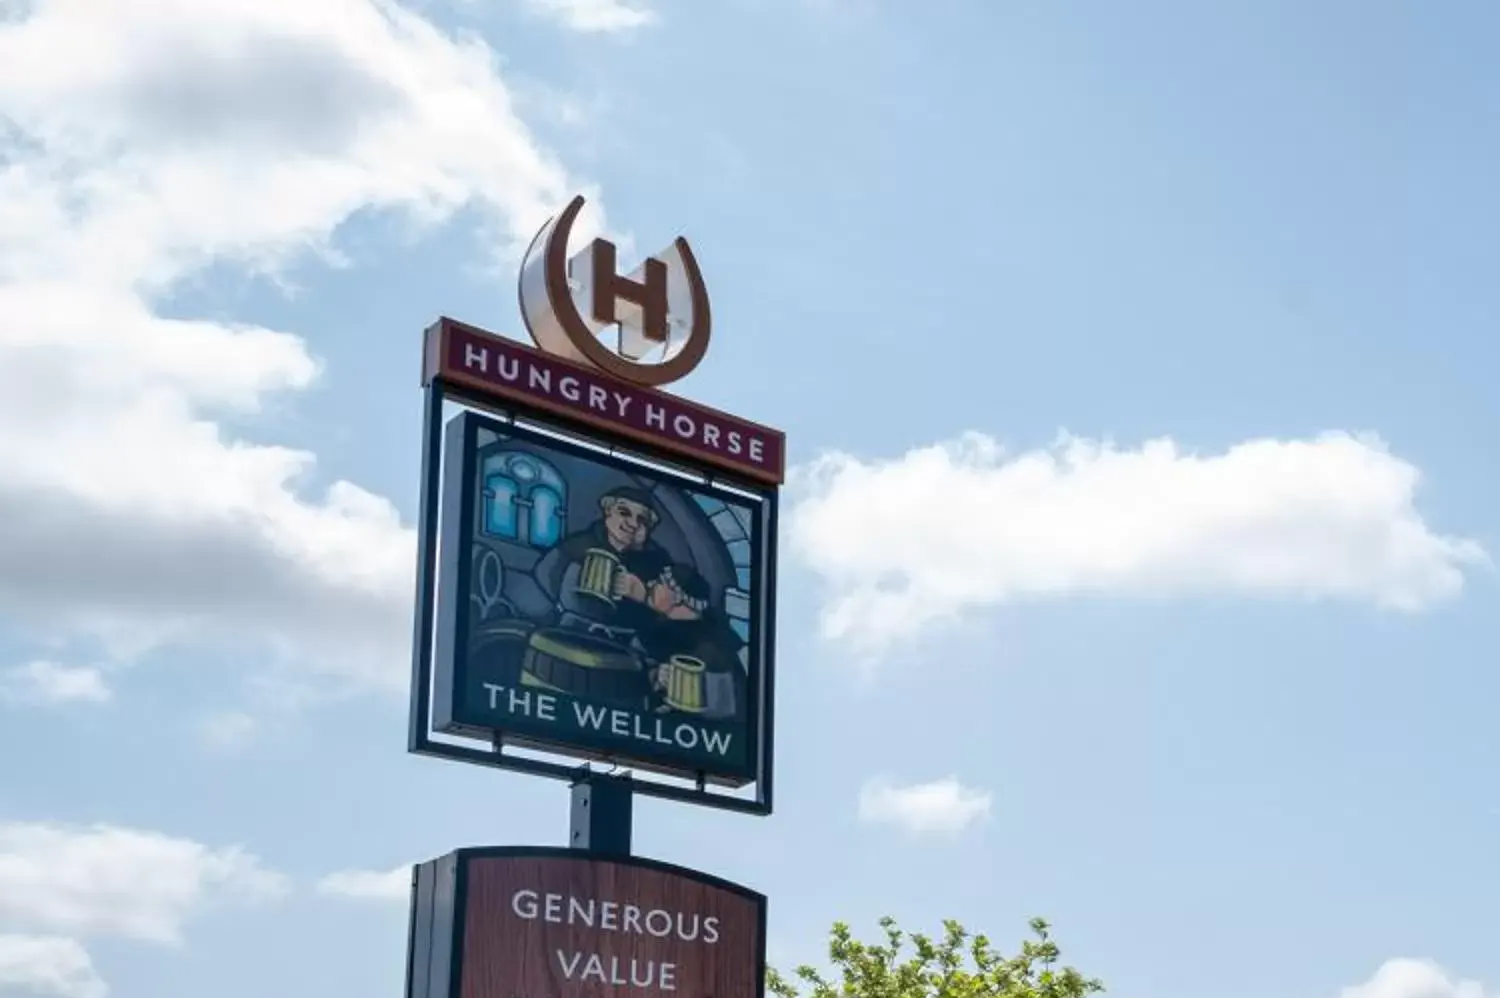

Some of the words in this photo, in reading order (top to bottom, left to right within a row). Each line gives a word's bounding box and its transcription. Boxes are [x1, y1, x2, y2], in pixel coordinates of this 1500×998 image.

[464, 343, 632, 418] HUNGRY
[644, 404, 765, 464] HORSE
[483, 682, 557, 722] THE
[572, 700, 732, 757] WELLOW
[511, 889, 721, 944] GENEROUS
[556, 948, 677, 991] VALUE
